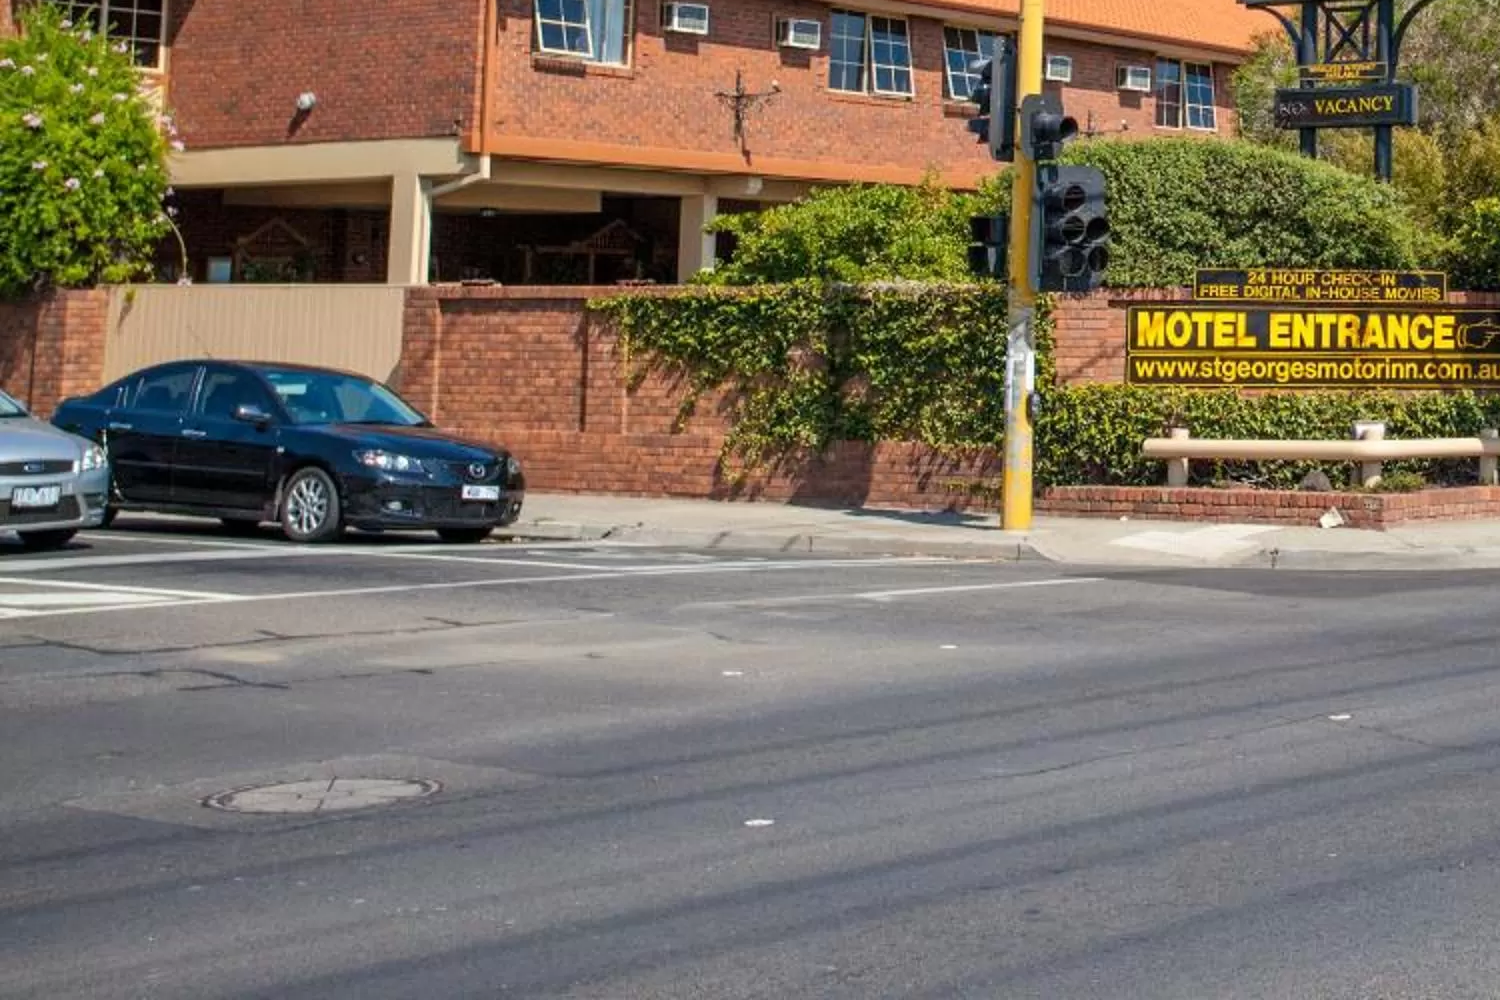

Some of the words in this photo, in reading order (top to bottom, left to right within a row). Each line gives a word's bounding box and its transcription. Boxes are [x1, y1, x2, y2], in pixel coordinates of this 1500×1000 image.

[1315, 95, 1393, 115] VACANCY
[1247, 271, 1265, 285] 24
[1272, 271, 1315, 285] HOUR
[1321, 273, 1396, 286] CHECK-IN
[1200, 285, 1239, 297] FREE
[1243, 285, 1300, 298] DIGITAL
[1306, 286, 1379, 299] IN-HOUSE
[1385, 287, 1441, 300] MOVIES
[1137, 311, 1257, 348] MOTEL
[1270, 312, 1455, 350] ENTRANCE
